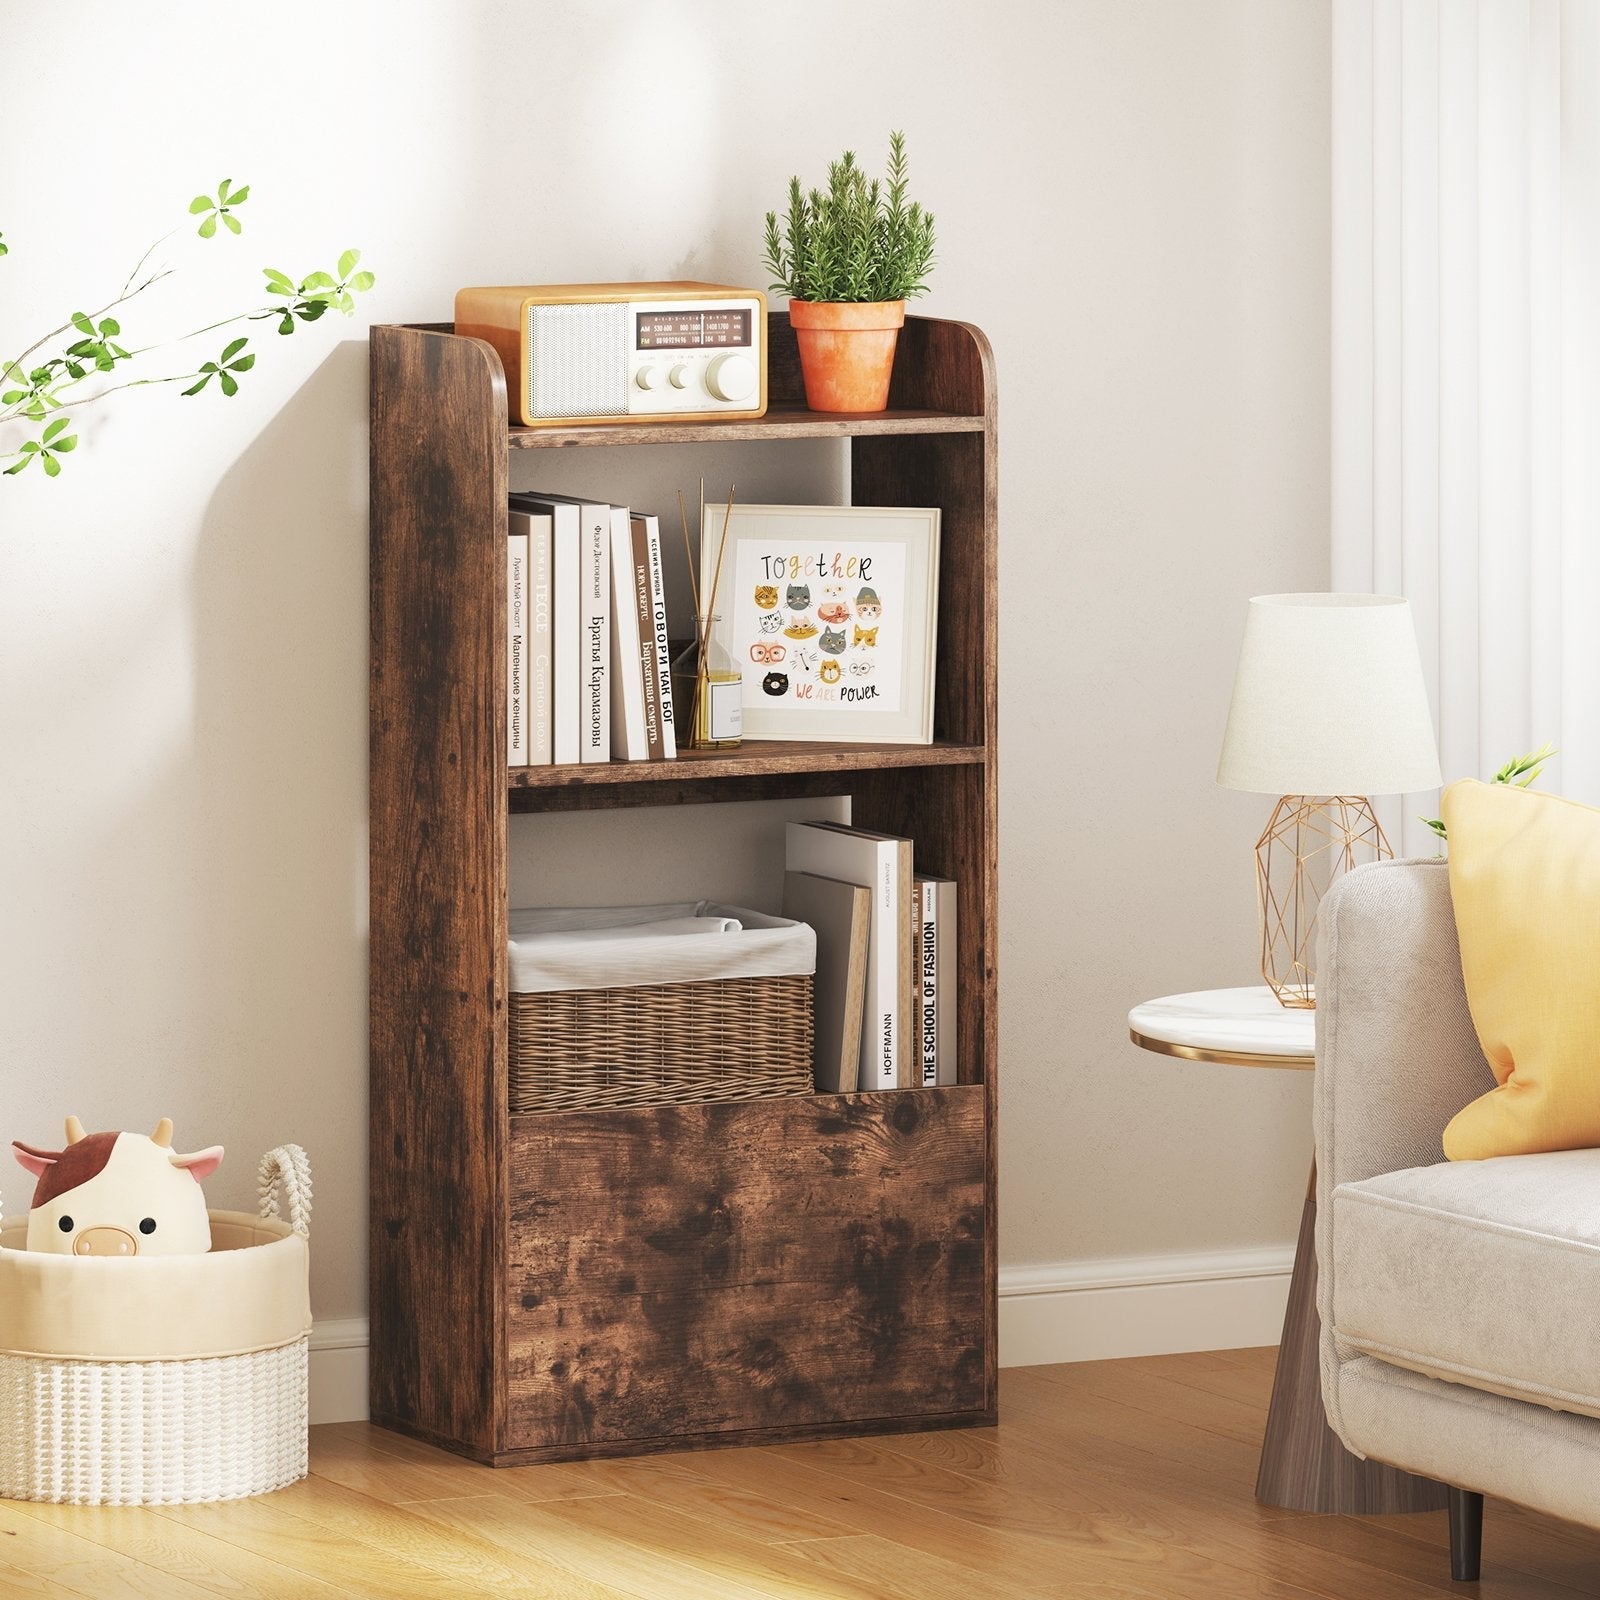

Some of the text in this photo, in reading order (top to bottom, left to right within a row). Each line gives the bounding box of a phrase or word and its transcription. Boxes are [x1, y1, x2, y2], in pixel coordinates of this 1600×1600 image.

[512, 558, 521, 581] Луиза
[536, 584, 548, 633] ГЕССЕ
[637, 565, 648, 620] НОРА РОБЕРТС
[512, 635, 522, 749] Маленькие женщины
[536, 654, 548, 752] Степной волк
[588, 616, 604, 747] Братья Карамазовы
[641, 641, 658, 744] Бархатная смерть
[654, 602, 672, 724] ГОВОРИ КАК БОГ
[816, 688, 836, 700] ARE
[924, 921, 935, 1082] THE SCHOOL OF FASHION
